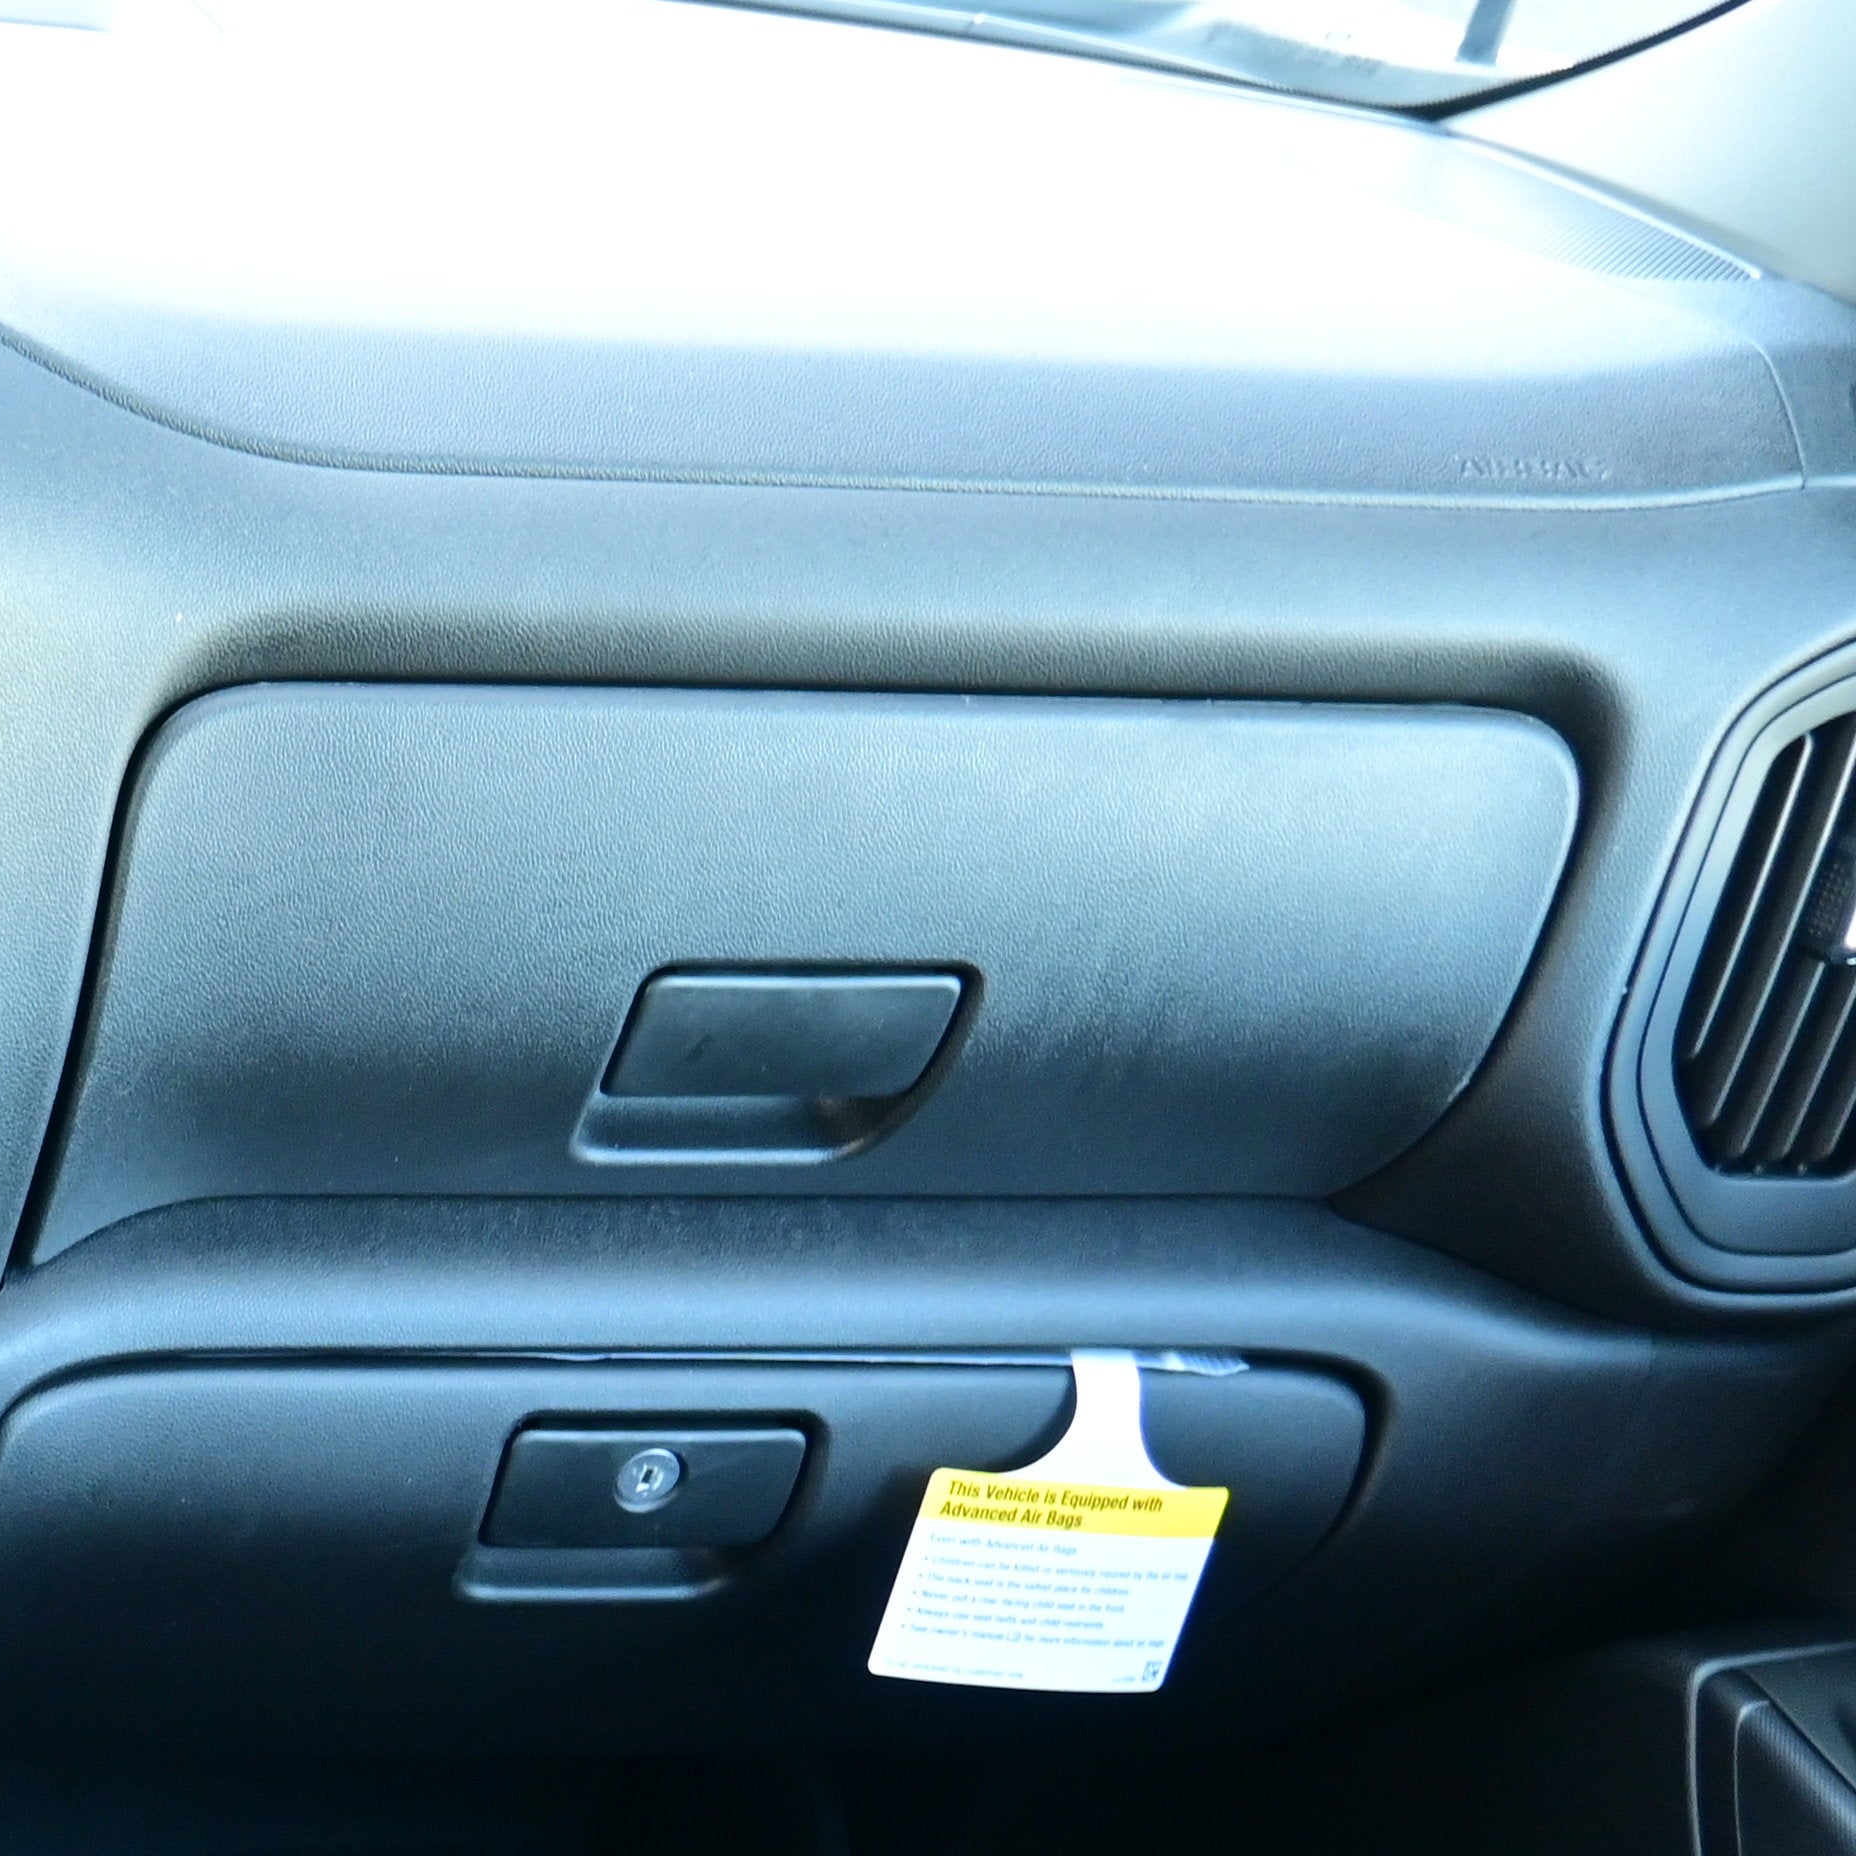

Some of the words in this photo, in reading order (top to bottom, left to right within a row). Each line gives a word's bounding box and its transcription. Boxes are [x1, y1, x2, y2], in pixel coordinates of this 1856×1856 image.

[949, 1480, 981, 1498] This
[987, 1484, 1040, 1503] Vehicle
[1043, 1489, 1057, 1504] is
[1061, 1490, 1129, 1512] Equipped
[1132, 1496, 1163, 1512] with
[939, 1501, 1018, 1522] Advanced
[1020, 1508, 1043, 1524] Air
[1046, 1510, 1083, 1530] Bags
